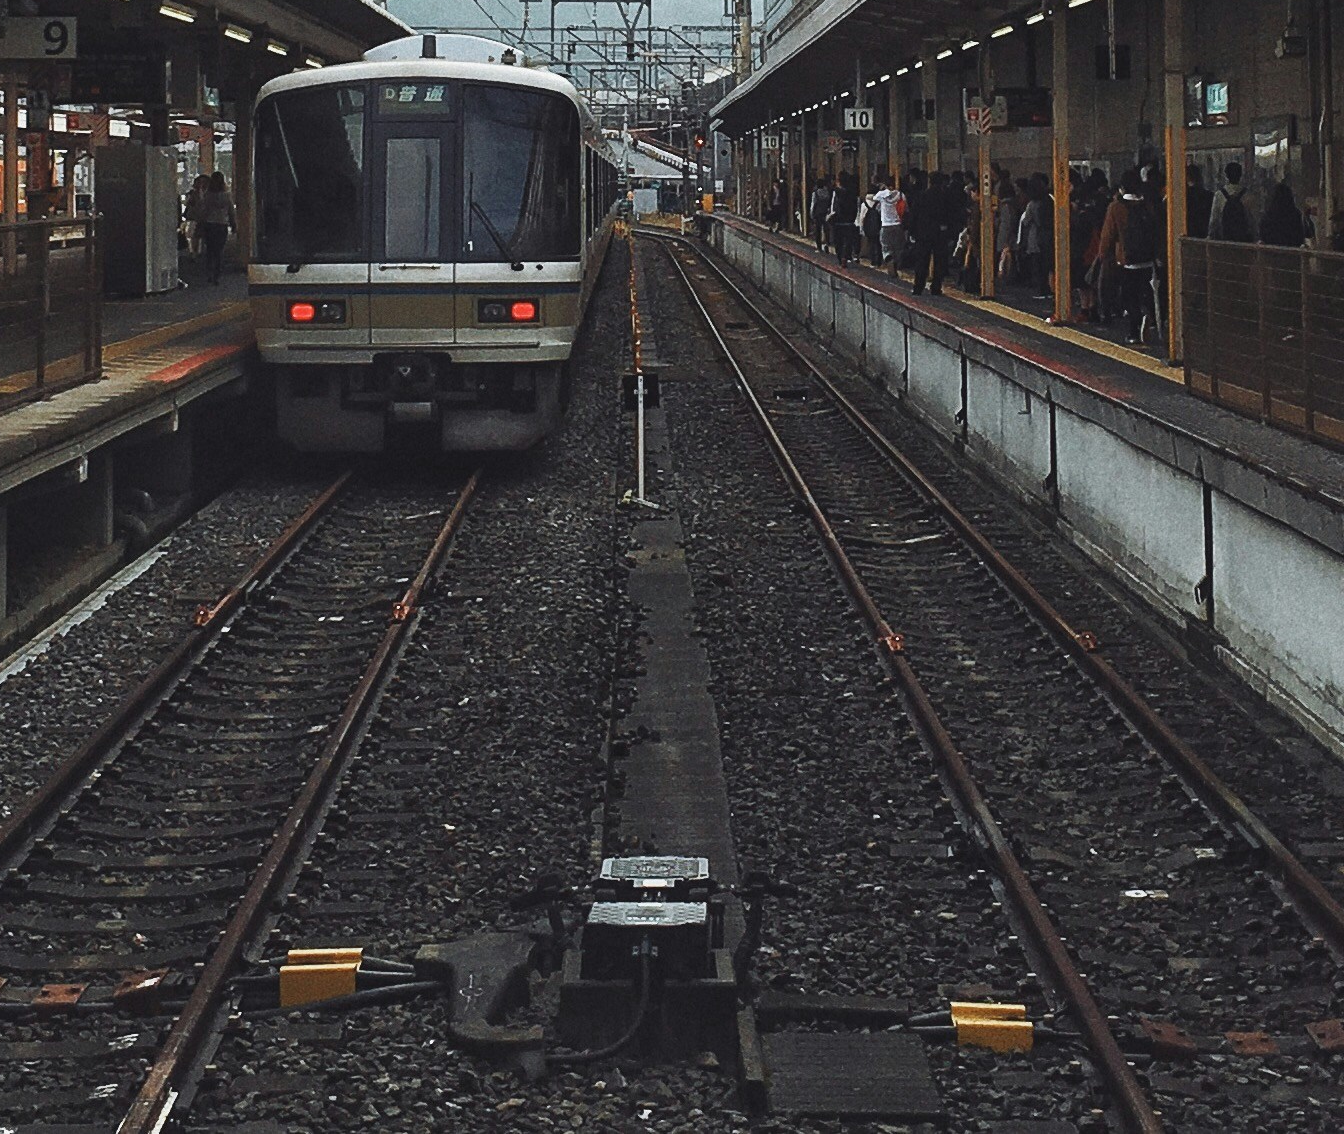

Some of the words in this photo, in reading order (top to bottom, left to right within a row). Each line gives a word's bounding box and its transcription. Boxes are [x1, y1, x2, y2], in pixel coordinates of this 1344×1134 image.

[43, 21, 69, 55] 9
[385, 87, 395, 99] D
[849, 111, 869, 128] 10
[764, 137, 777, 147] 10
[467, 240, 474, 252] 1
